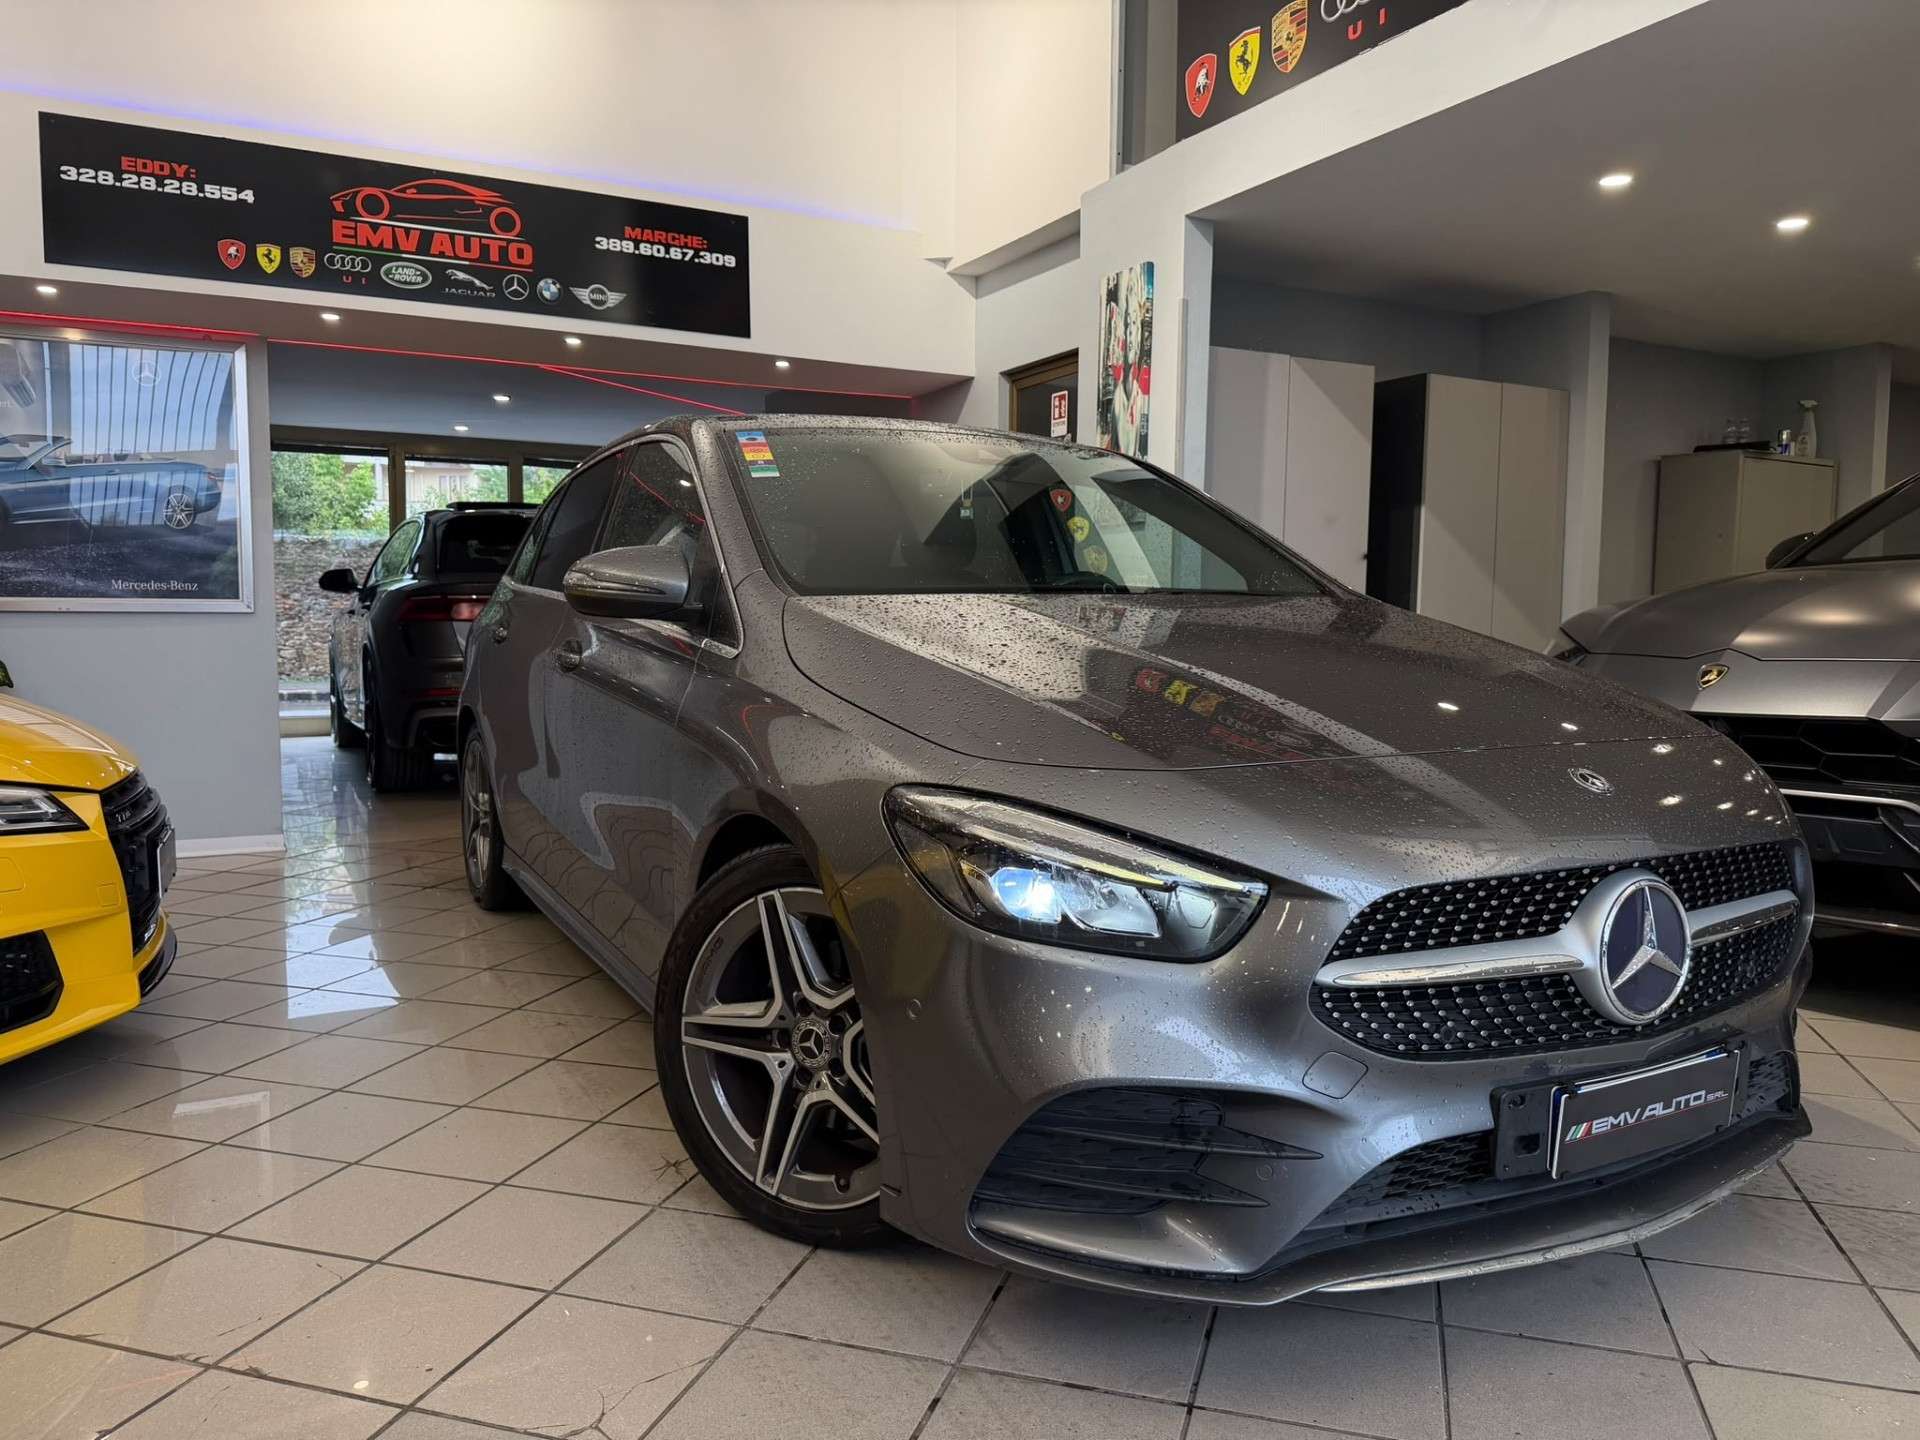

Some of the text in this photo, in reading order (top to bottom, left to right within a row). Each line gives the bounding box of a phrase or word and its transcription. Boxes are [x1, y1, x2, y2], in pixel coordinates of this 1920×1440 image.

[121, 156, 197, 179] EDDY:
[60, 165, 255, 204] 328.28.28.554
[332, 219, 534, 266] EMV AUTO
[624, 226, 708, 249] MARCHE:
[595, 236, 736, 268] 389.60.67.309
[391, 266, 415, 276] LAND
[393, 273, 423, 283] ROVER
[442, 287, 496, 298] JAGUAR
[589, 293, 608, 301] MINI
[111, 578, 199, 591] Mercedes-Benz
[1591, 1090, 1729, 1134] EMV AUTO SRL
